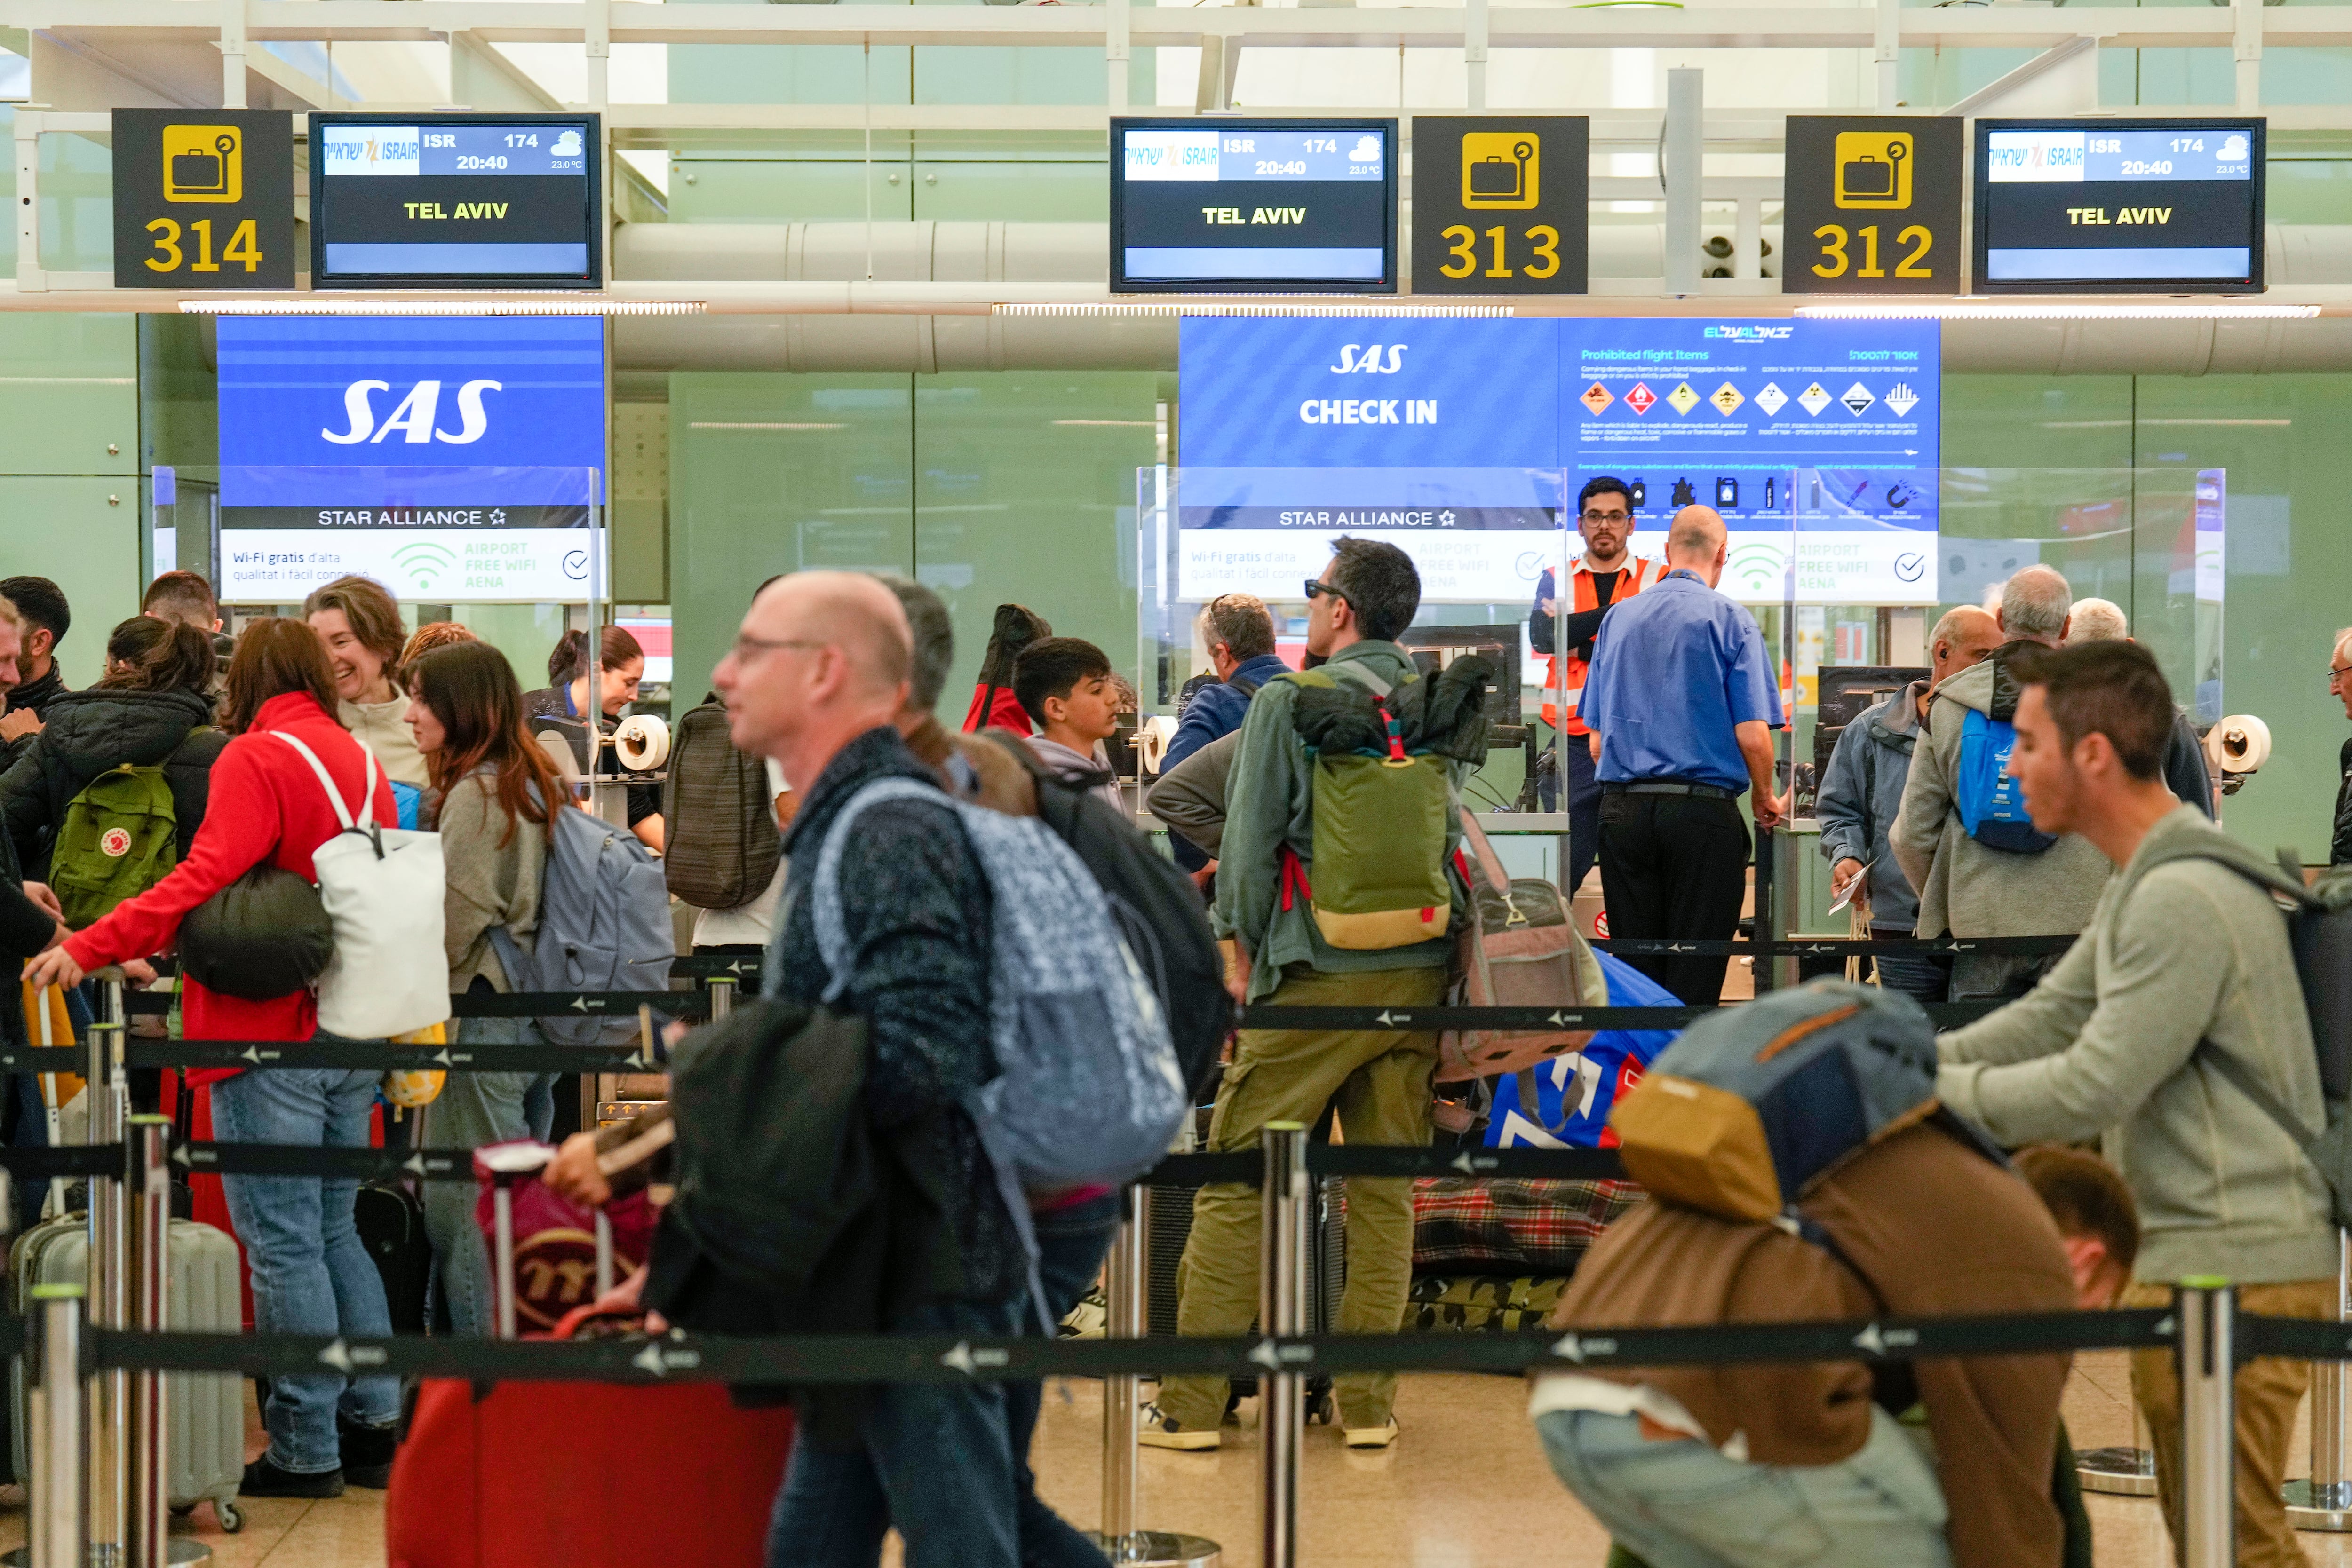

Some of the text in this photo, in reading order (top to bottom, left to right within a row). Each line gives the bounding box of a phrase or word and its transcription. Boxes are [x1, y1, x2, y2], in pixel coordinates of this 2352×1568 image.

[424, 134, 538, 147] ISR 174
[1224, 139, 1337, 153] ISR 174
[2089, 139, 2204, 153] ISR 174
[382, 142, 418, 159] ISRAIR
[1183, 147, 1217, 165] ISRAIR
[2047, 148, 2082, 165] ISRAIR
[457, 155, 507, 169] 20:40
[1255, 161, 1306, 174] 20:40
[2121, 161, 2172, 174] 20:40
[404, 203, 508, 219] TEL AVIV
[1202, 207, 1306, 224] TEL AVIV
[2067, 207, 2172, 224] TEL AVIV
[144, 218, 262, 272] 314
[1439, 224, 1560, 278] 313
[1812, 224, 1932, 278] 312
[1330, 344, 1408, 373] SAS
[1582, 349, 1709, 362] Prohibited flight Items
[322, 380, 502, 444] SAS
[1300, 400, 1437, 424] CHECK IN
[319, 511, 481, 525] STAR ALLIANCE
[1280, 511, 1433, 526] STAR ALLIANCE
[465, 543, 527, 554] AIRPORT
[1419, 543, 1481, 555] AIRPORT
[1798, 545, 1860, 556] AIRPORT
[234, 553, 340, 565] Wi-Fi gratis d'alta
[466, 559, 536, 571] FREE WIFI
[1192, 552, 1296, 564] Wi-Fi gratis d'alta
[1420, 560, 1489, 571] FREE WIFI
[1799, 561, 1868, 572] FREE WIFI
[234, 569, 278, 581] qualitat
[282, 569, 286, 579] i
[288, 569, 312, 579] fàcil
[1191, 568, 1235, 580] qualitat
[1238, 568, 1242, 578] i
[1245, 568, 1269, 578] fàcil
[465, 576, 504, 588] AENA
[1799, 578, 1836, 589] AENA
